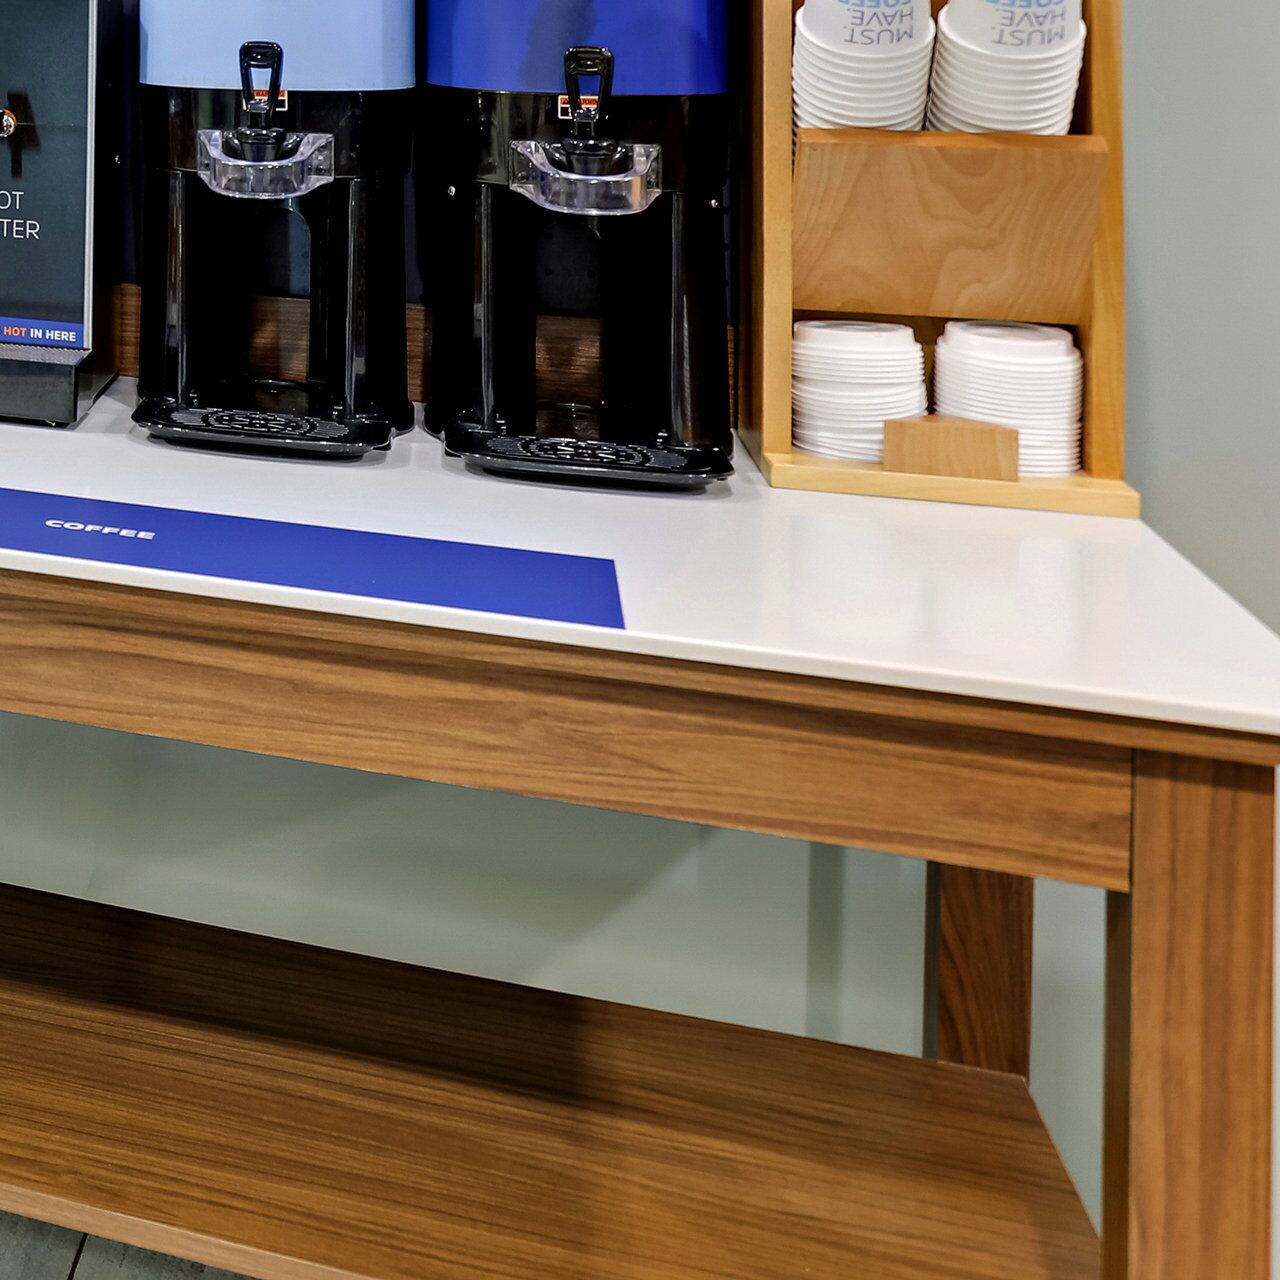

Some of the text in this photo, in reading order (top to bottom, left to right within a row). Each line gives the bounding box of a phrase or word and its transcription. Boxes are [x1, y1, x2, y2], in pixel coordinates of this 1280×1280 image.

[846, 6, 914, 27] HAVE.
[842, 24, 914, 46] MUST.
[3, 326, 27, 337] HOT
[30, 328, 43, 339] IN
[45, 330, 77, 342] HERE
[44, 519, 157, 541] COFFEE
